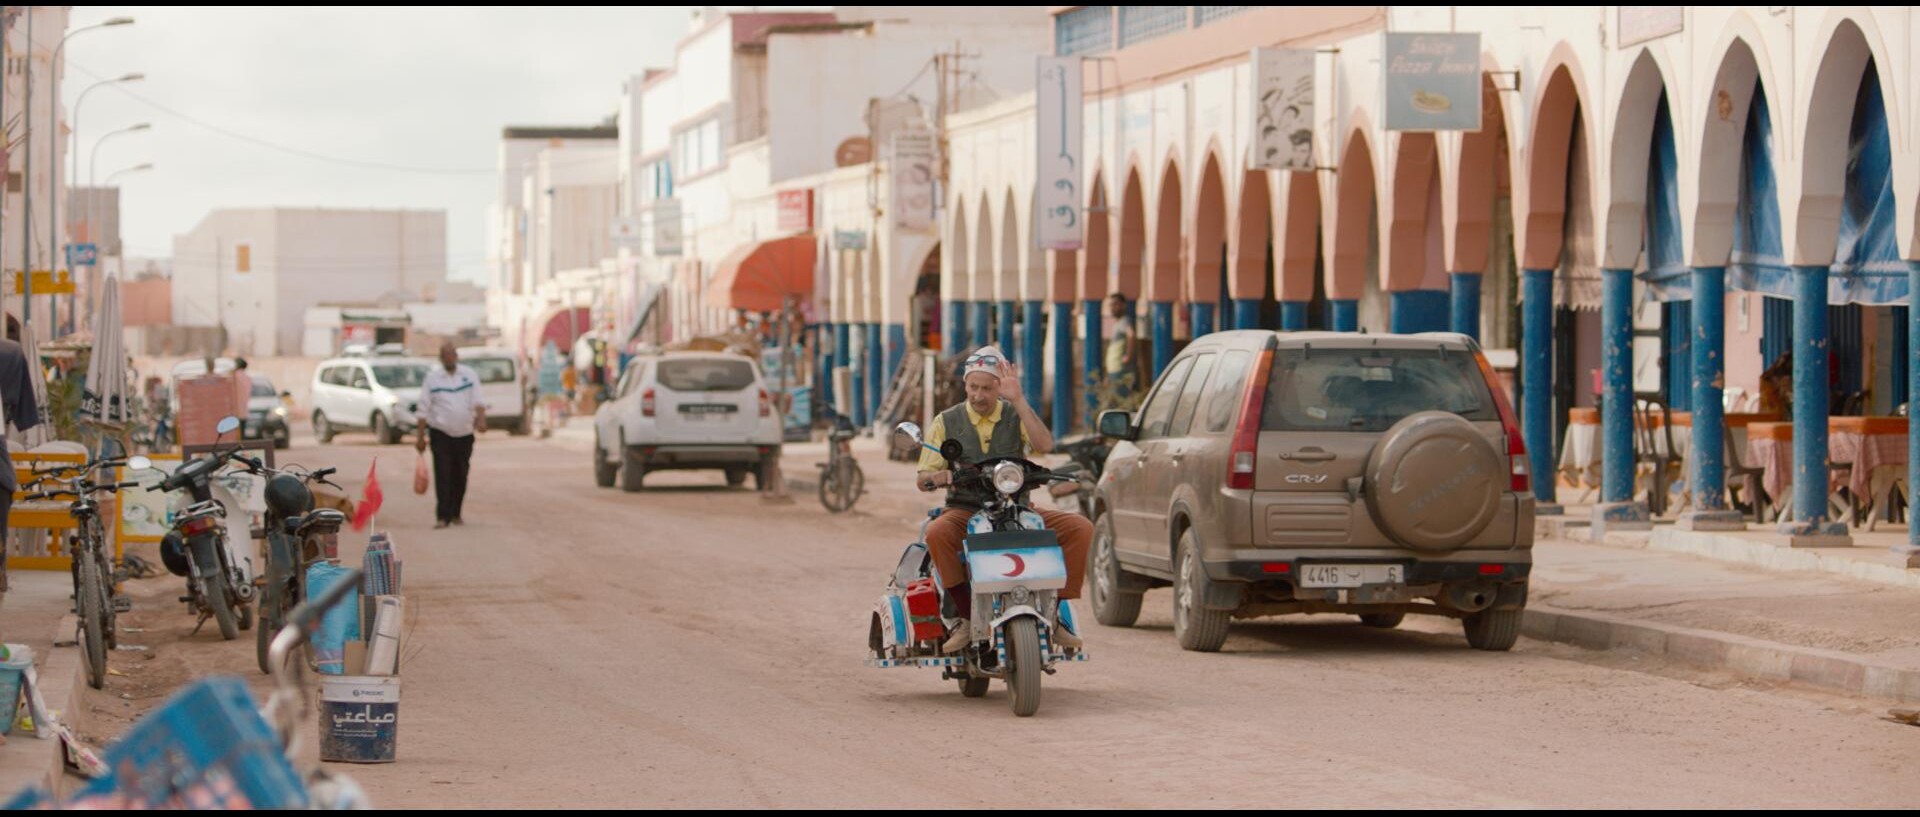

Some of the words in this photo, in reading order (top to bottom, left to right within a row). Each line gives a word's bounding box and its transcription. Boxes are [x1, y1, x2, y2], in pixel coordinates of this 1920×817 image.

[1285, 474, 1328, 484] CR-V
[1307, 567, 1339, 583] 4416
[1387, 567, 1397, 582] 6
